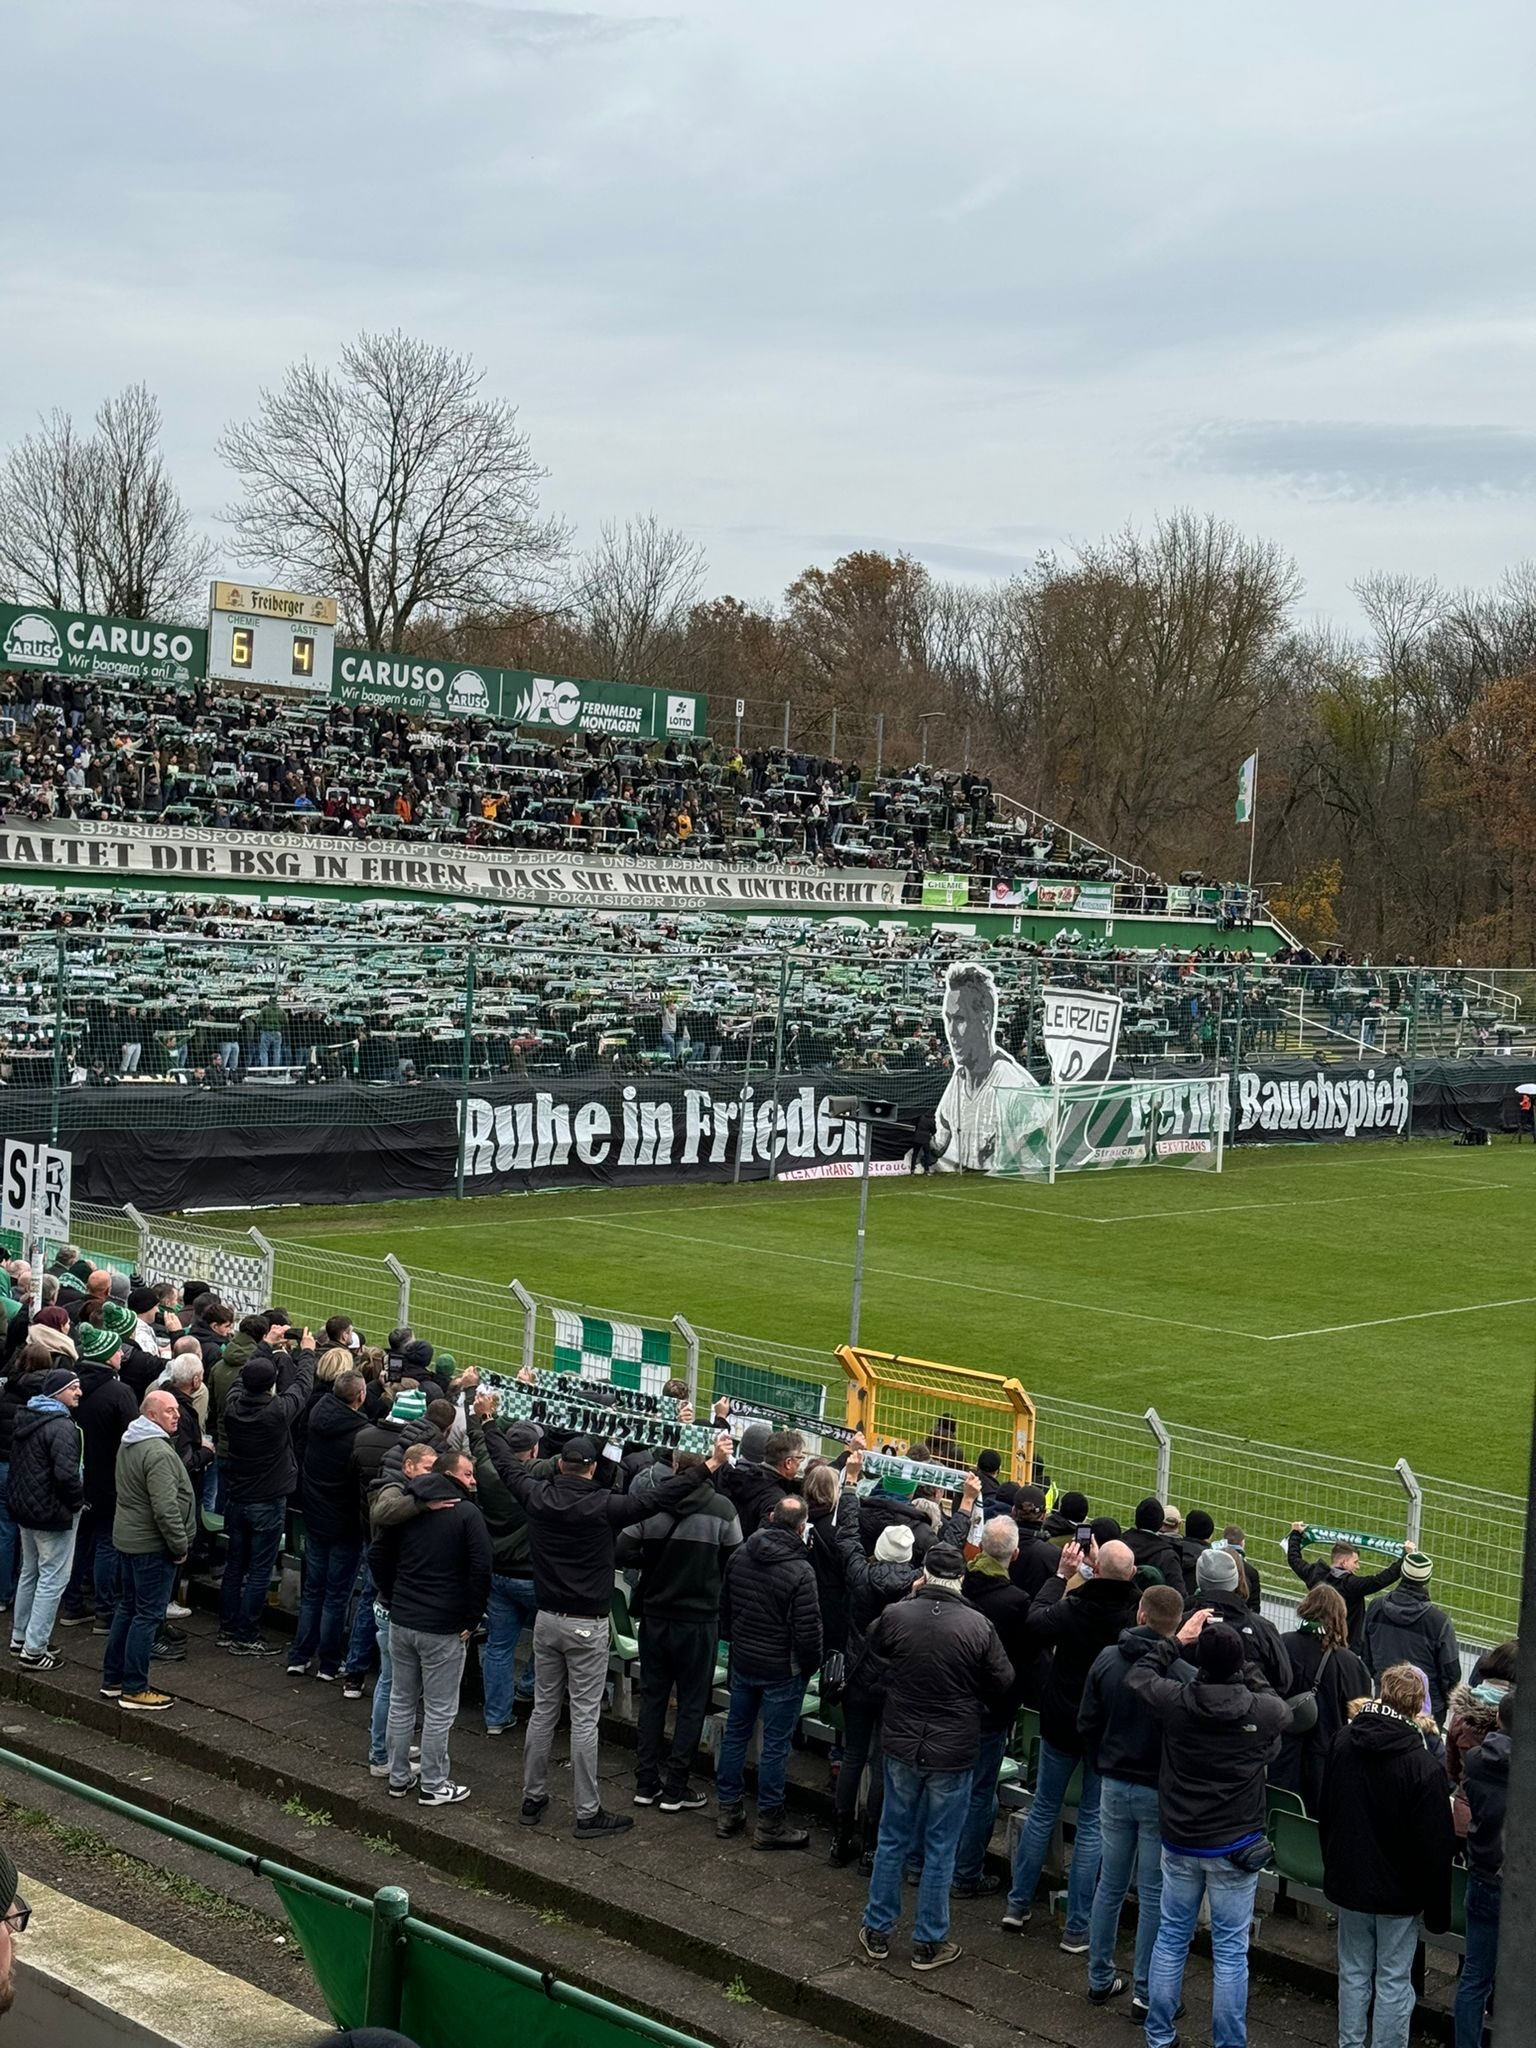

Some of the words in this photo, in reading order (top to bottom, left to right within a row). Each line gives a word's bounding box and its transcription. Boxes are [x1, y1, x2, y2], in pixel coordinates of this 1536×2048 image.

[251, 591, 304, 617] Freiberger
[228, 614, 260, 628] CHEMIE
[3, 640, 63, 659] CARUSO
[67, 622, 193, 662] CARUSO
[232, 632, 248, 663] 6
[68, 652, 90, 668] Wir
[92, 654, 148, 676] baggern's
[151, 664, 170, 679] an!
[294, 642, 309, 670] 4
[341, 657, 444, 692] CARUSO
[341, 686, 360, 699] Wir
[362, 686, 407, 706] baggern's
[410, 695, 426, 708] an!
[446, 694, 490, 708] CARUSO
[582, 702, 642, 719] FERNMELDE
[669, 716, 692, 726] LOTTO
[579, 717, 640, 734] MONTAGEN
[78, 822, 432, 856] BETRIEBSSPORTGEMEINSCHAFT
[438, 848, 514, 864] CHEMIE
[518, 854, 584, 866] LEIPZIG
[601, 856, 657, 869] UNSER
[662, 859, 714, 871] LEBEN
[718, 862, 750, 873] NUR
[788, 865, 826, 878] DICH
[150, 845, 216, 872] DIE
[229, 850, 301, 876] BSG
[314, 855, 348, 878] IN
[488, 868, 566, 890] DASS
[572, 870, 618, 892] SIE
[622, 872, 732, 897] NIEMALS
[738, 878, 877, 902] UNTERGEHT
[928, 881, 964, 889] CHEMIE
[499, 888, 536, 900] 1964
[548, 892, 666, 908] POKALSIEGER
[671, 897, 706, 908] 1966
[1046, 1004, 1109, 1034] LEIPZIG
[454, 1092, 611, 1177] Ruhe
[618, 1086, 674, 1165] in
[680, 1087, 866, 1163] Frieden
[8, 1148, 28, 1210] S
[1312, 1528, 1362, 1544] CHEMIE
